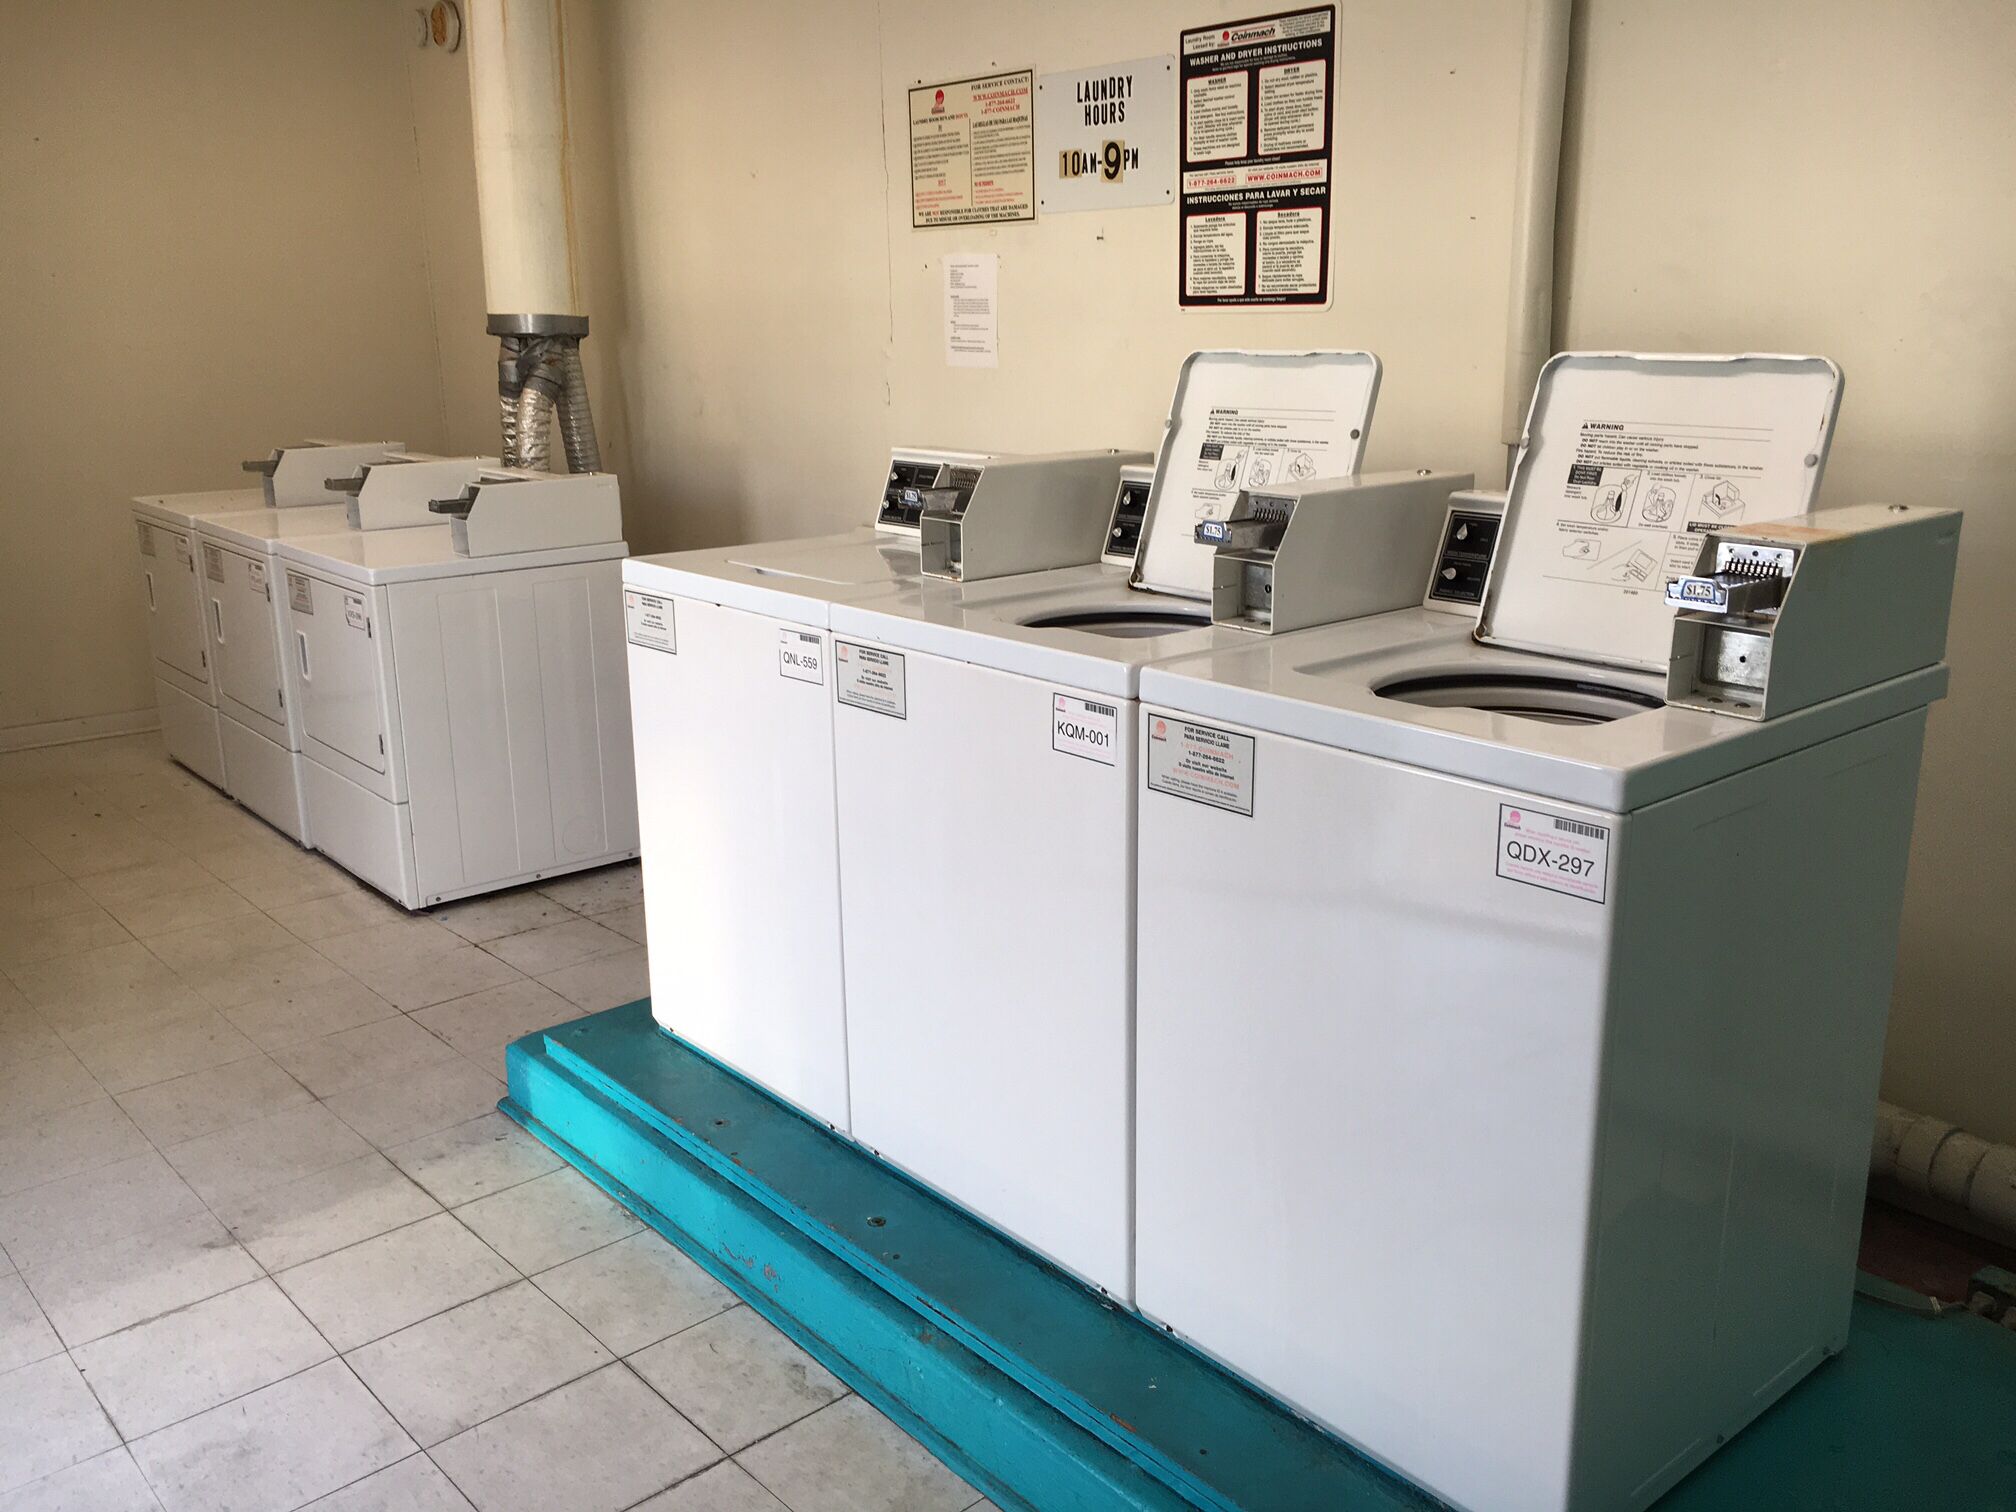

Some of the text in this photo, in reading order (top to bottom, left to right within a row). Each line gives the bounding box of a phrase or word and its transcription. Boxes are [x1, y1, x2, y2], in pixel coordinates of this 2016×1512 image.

[1231, 27, 1275, 41] Coinmach
[1190, 54, 1219, 66] WASHER
[1220, 52, 1236, 62] AND
[1238, 48, 1262, 59] DRYER
[1264, 38, 1322, 55] INSTRUCTIONS
[982, 81, 1002, 89] SERVICE
[1077, 75, 1132, 103] LAUNDRY
[1085, 101, 1125, 126] HOURS
[1248, 169, 1321, 182] WWW.COINMACH.COM
[1187, 193, 1243, 205] INSTRUCCIONES
[1245, 190, 1264, 200] PARA
[1267, 188, 1290, 198] LAVAR
[1293, 188, 1298, 196] Y
[1300, 186, 1326, 195] SECAR
[1685, 584, 1711, 596] $1.75
[783, 651, 818, 670] QNL-559
[1058, 720, 1108, 747] KQM-001
[1184, 726, 1230, 742] FOR SERVICE CALL
[1184, 733, 1230, 749] PARA SERVICIO LLAME
[1507, 840, 1595, 877] QDX-297
